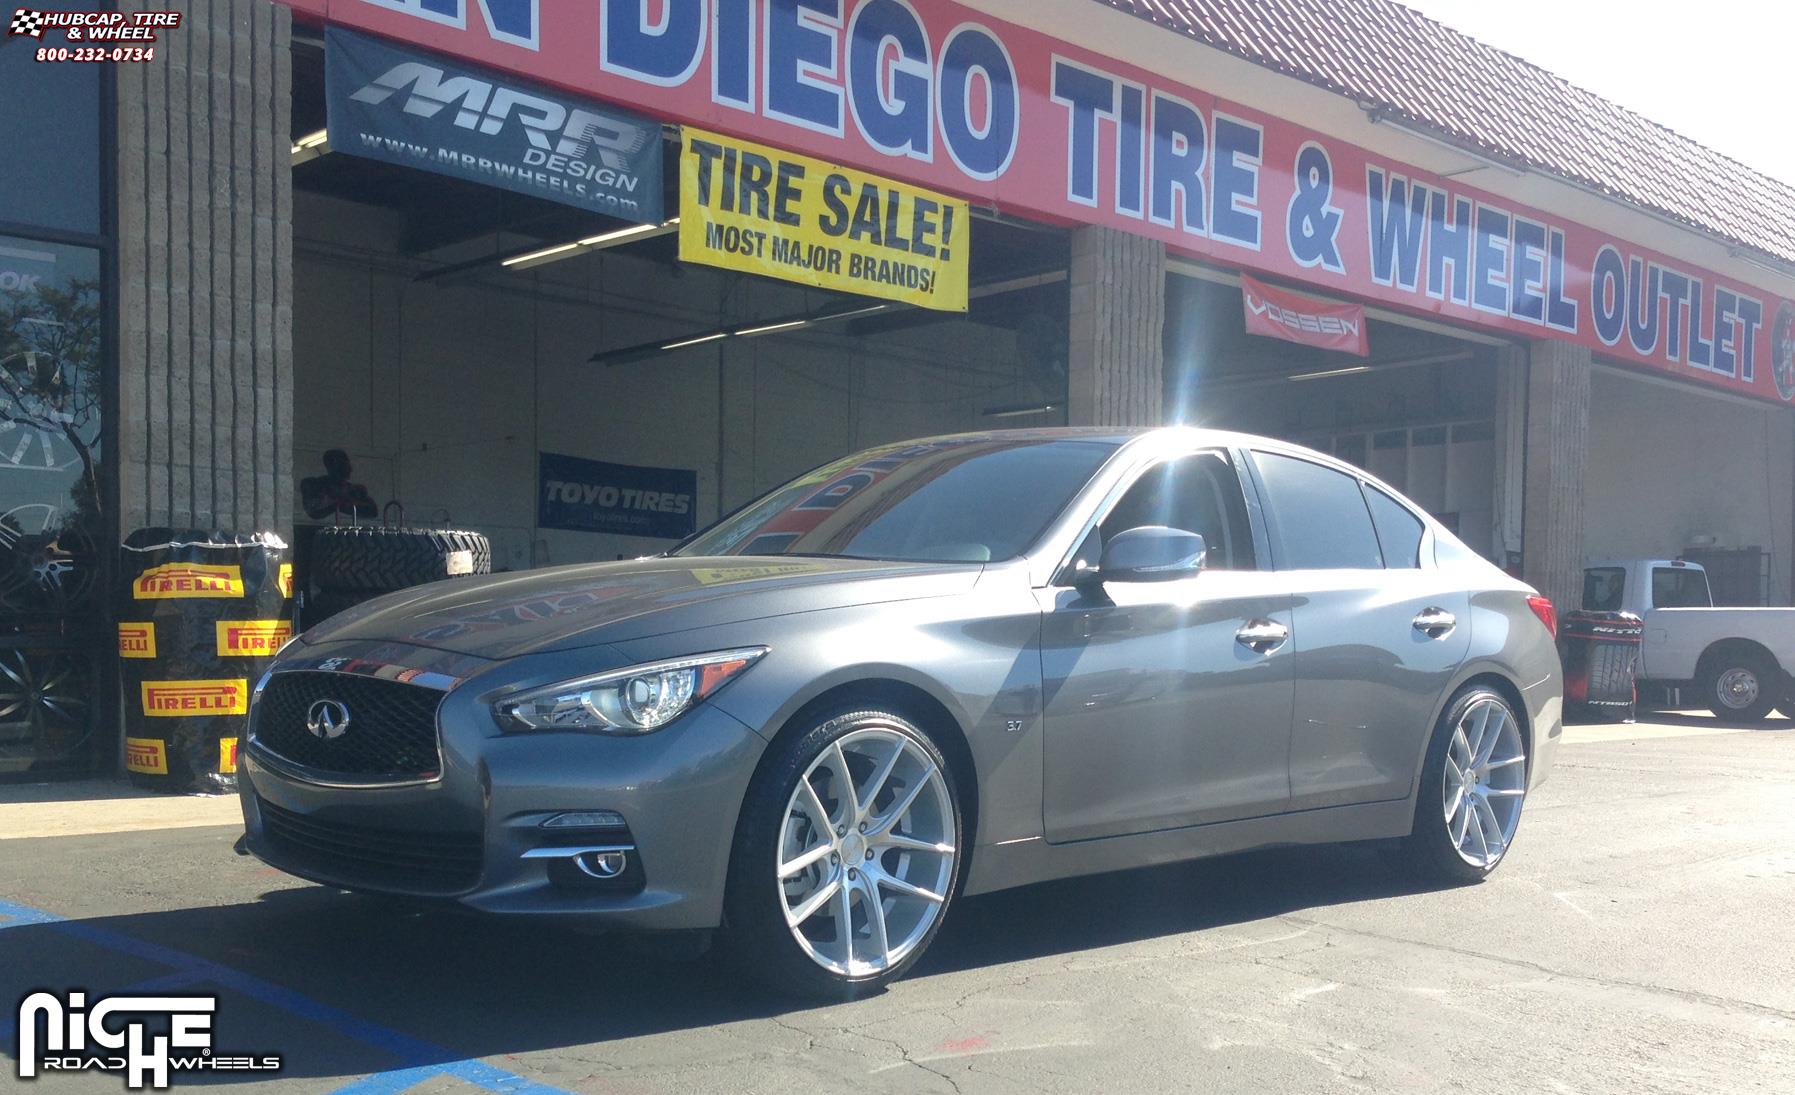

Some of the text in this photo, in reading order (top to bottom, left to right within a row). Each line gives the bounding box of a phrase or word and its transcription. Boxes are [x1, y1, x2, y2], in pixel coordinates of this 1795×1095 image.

[350, 61, 646, 172] MRR
[522, 148, 639, 193] DESIGN
[600, 0, 1763, 384] DIEGO TIRE & WHEEL OUTLET
[690, 138, 955, 262] TIRE SALE!
[705, 221, 937, 295] MOST MAJOR BRANDS!
[1246, 294, 1359, 337] VOSSEN
[140, 568, 231, 592] PIRELLI
[147, 687, 238, 709] PIRELLI
